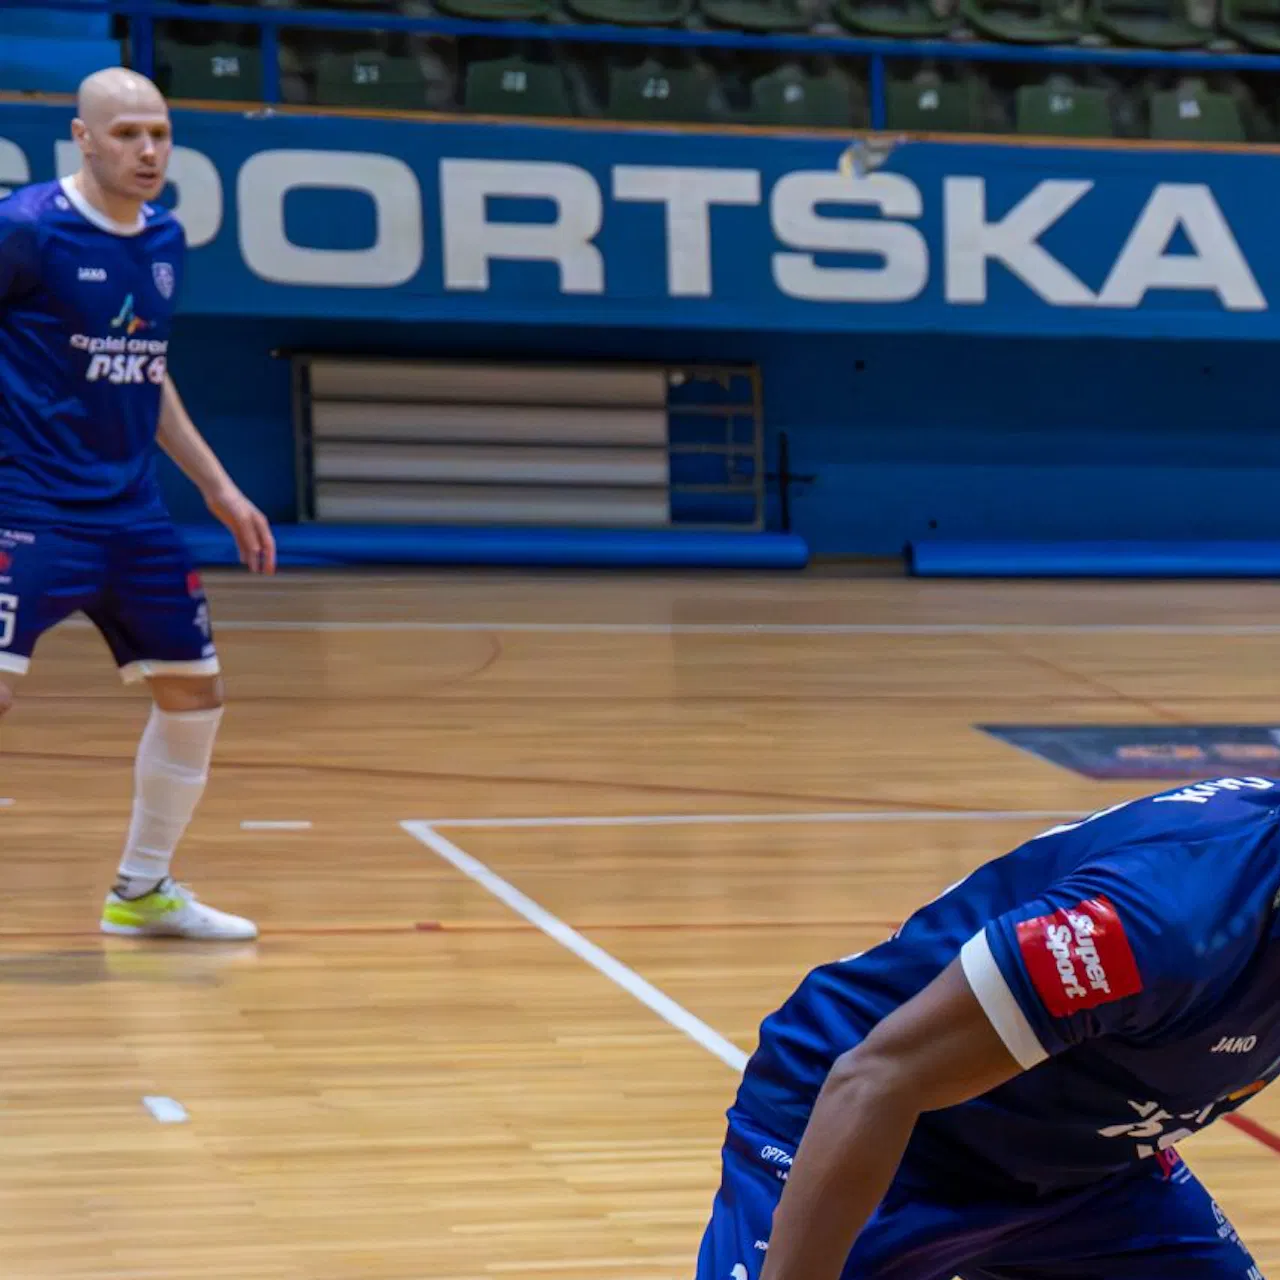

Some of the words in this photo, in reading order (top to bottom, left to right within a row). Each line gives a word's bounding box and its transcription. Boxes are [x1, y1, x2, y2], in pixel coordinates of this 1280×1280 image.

[0, 136, 1267, 312] PORTSKA
[1046, 924, 1087, 999] Sport
[1067, 914, 1111, 993] Super
[1210, 1034, 1257, 1053] JAKO
